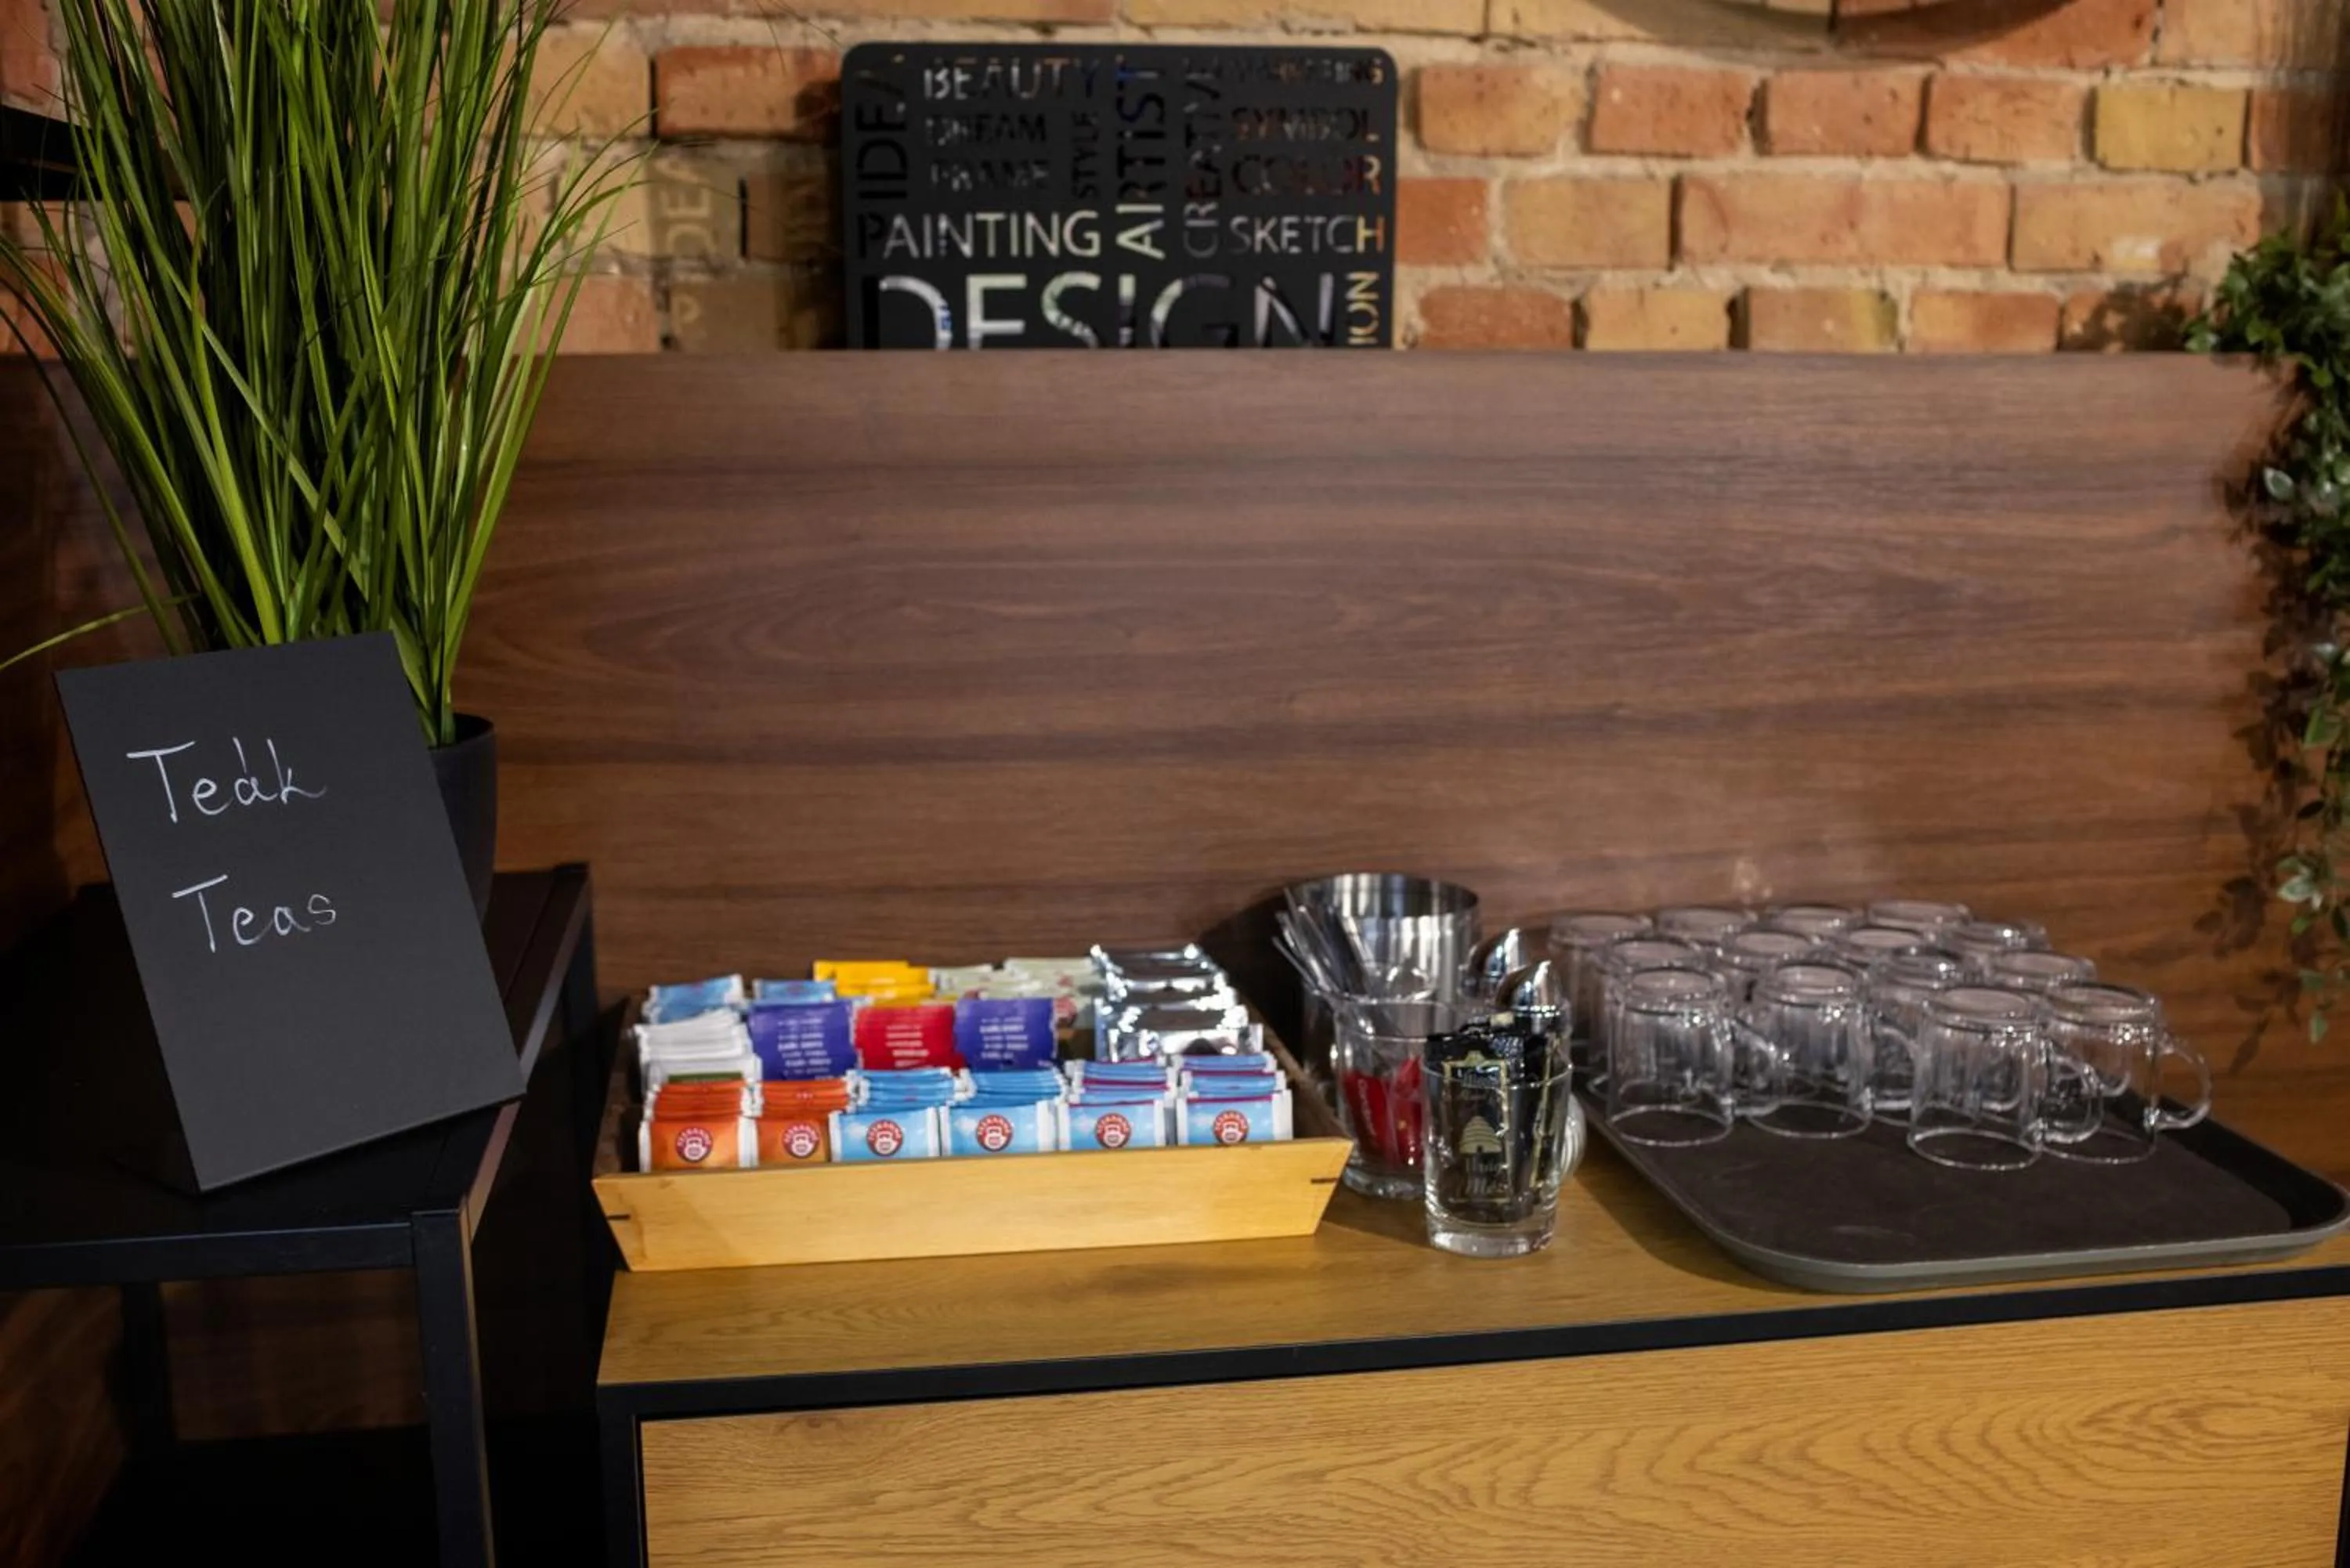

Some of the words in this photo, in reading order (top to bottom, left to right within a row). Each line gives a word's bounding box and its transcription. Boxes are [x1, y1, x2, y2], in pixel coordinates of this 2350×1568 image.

[923, 56, 1099, 100] BEAUTY
[926, 112, 1047, 145] DREAM
[1115, 54, 1166, 260] ARTIST
[1183, 56, 1222, 258] CREATIVE
[859, 210, 1101, 259] PAINTING
[1230, 215, 1384, 254] SKETCH
[862, 272, 1334, 349] DESIGN
[126, 736, 327, 823] Teak
[172, 874, 337, 953] Teas
